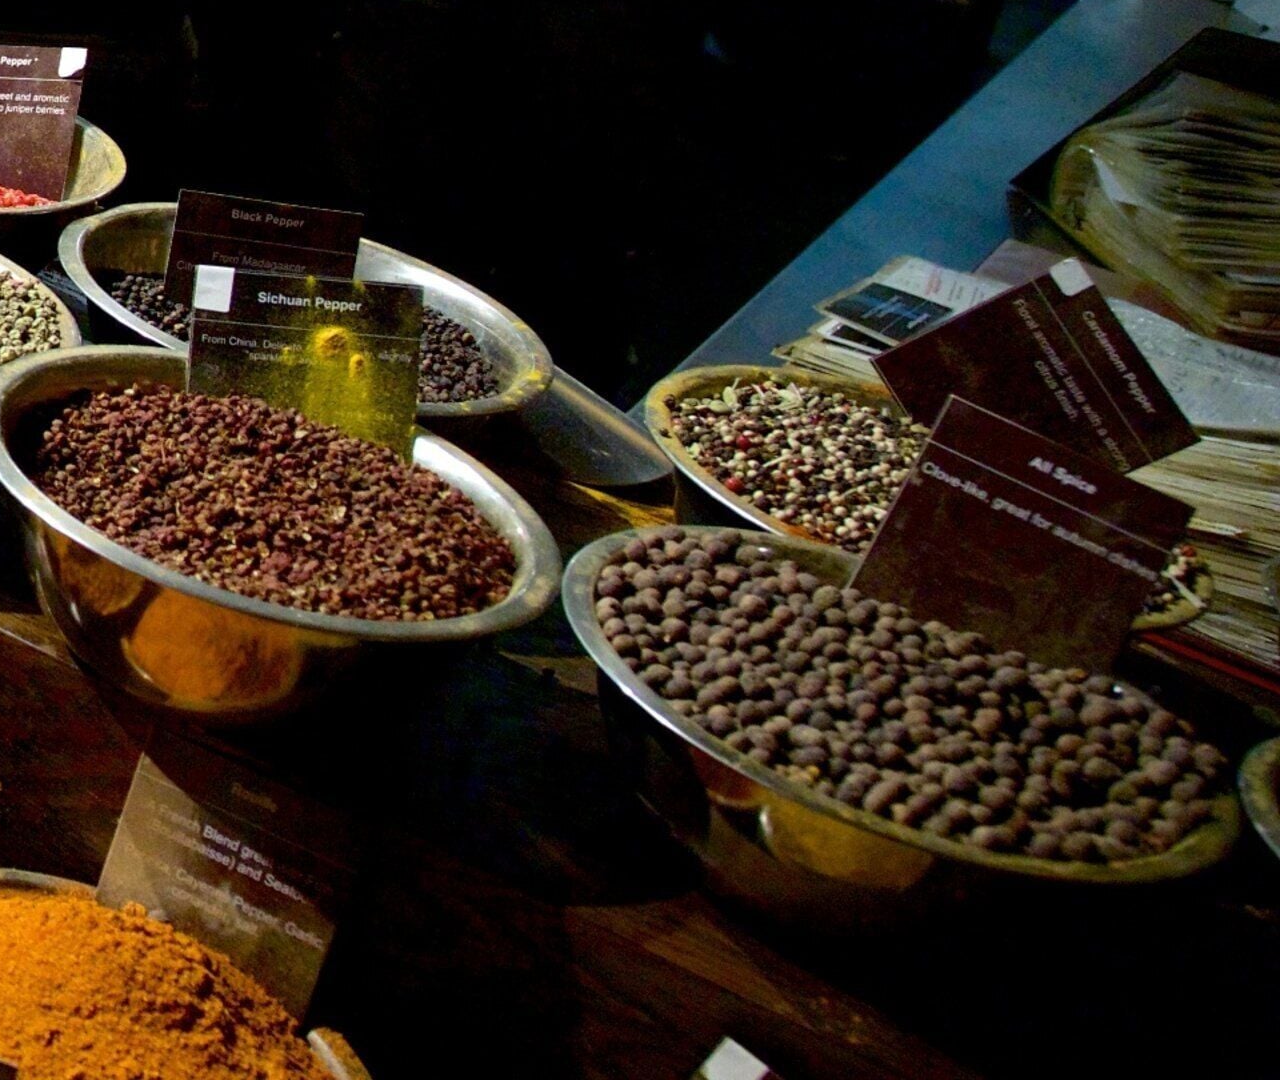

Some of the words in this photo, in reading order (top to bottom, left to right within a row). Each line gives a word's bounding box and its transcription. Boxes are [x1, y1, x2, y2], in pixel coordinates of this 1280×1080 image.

[0, 56, 32, 67] Pepper
[15, 92, 31, 101] and
[33, 93, 70, 103] aromatic
[4, 104, 34, 115] juniper
[231, 209, 263, 222] Black
[265, 213, 304, 228] Pepper
[211, 250, 239, 265] From
[257, 291, 312, 307] Sichuan
[315, 296, 363, 313] Pepper
[201, 333, 226, 345] From
[1012, 298, 1039, 330] Floral
[1032, 329, 1069, 376] aromatic
[1062, 375, 1086, 403] taste
[1082, 403, 1104, 427] with
[1083, 310, 1128, 374] Cardamom
[1122, 372, 1157, 414] Pepper
[1034, 360, 1059, 390] citrus
[1028, 456, 1055, 475] All
[1050, 466, 1098, 496] Spice
[990, 497, 1032, 523] great
[1030, 512, 1053, 531] for
[203, 824, 240, 852] Blend
[236, 862, 262, 882] and
